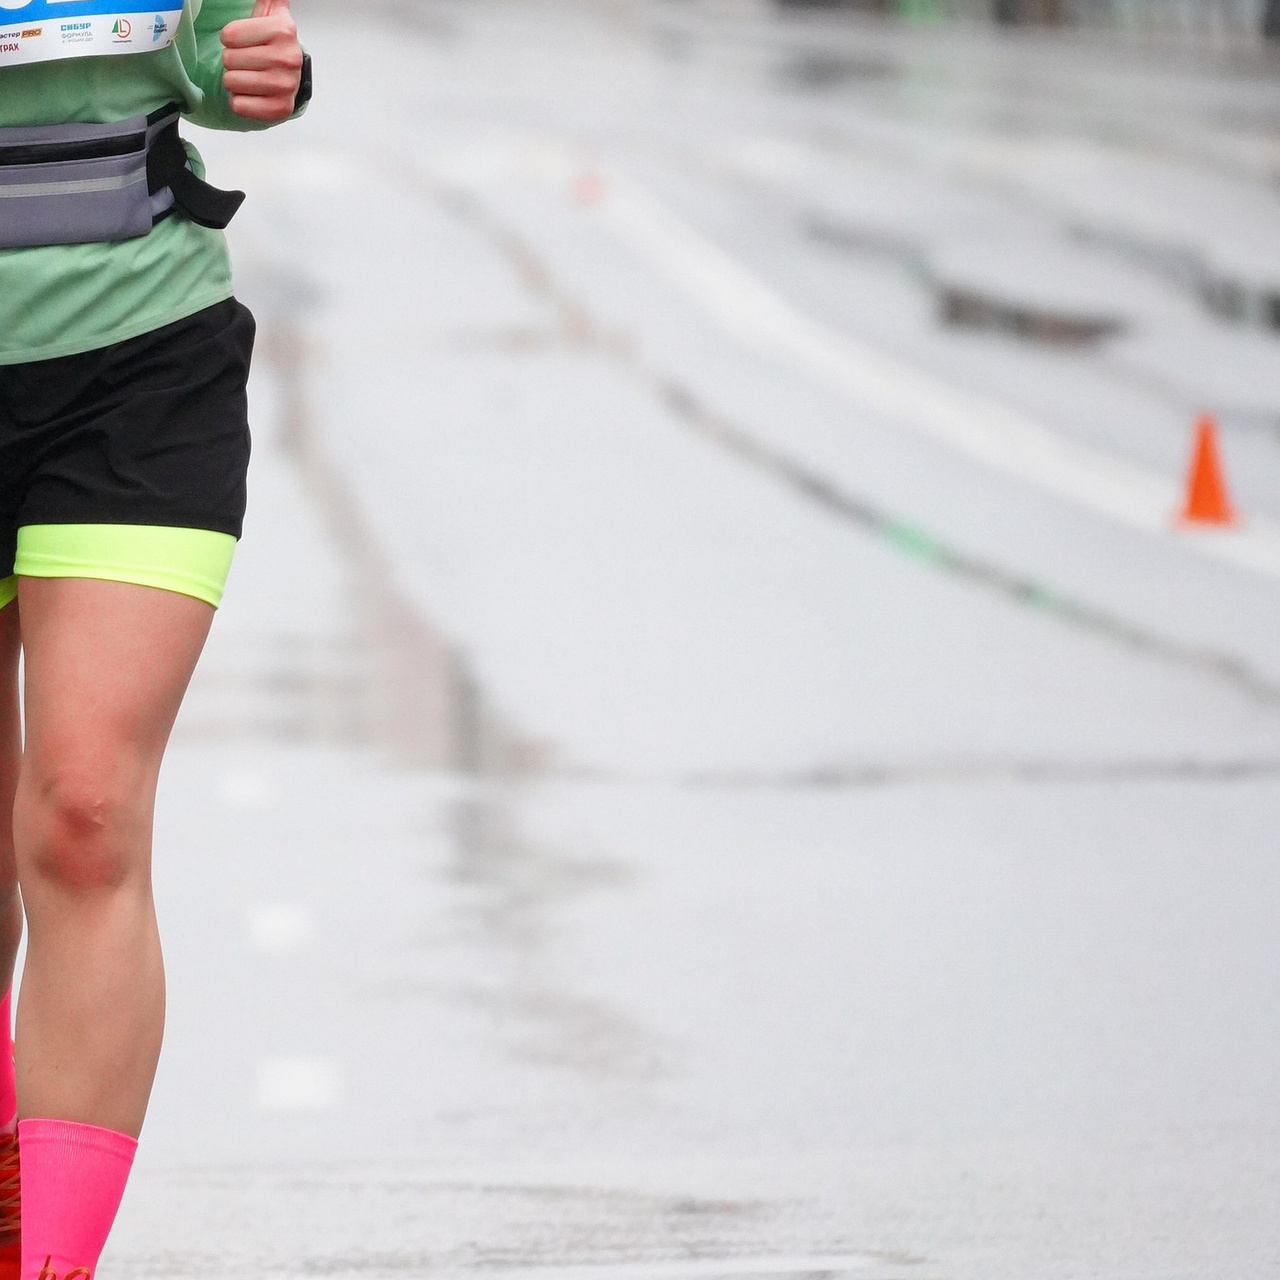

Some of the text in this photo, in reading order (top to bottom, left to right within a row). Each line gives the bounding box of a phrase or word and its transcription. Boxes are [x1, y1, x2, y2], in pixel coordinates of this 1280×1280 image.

[60, 22, 91, 31] СИБУР
[22, 29, 41, 37] PRO
[61, 31, 93, 39] ФОРМУЛА
